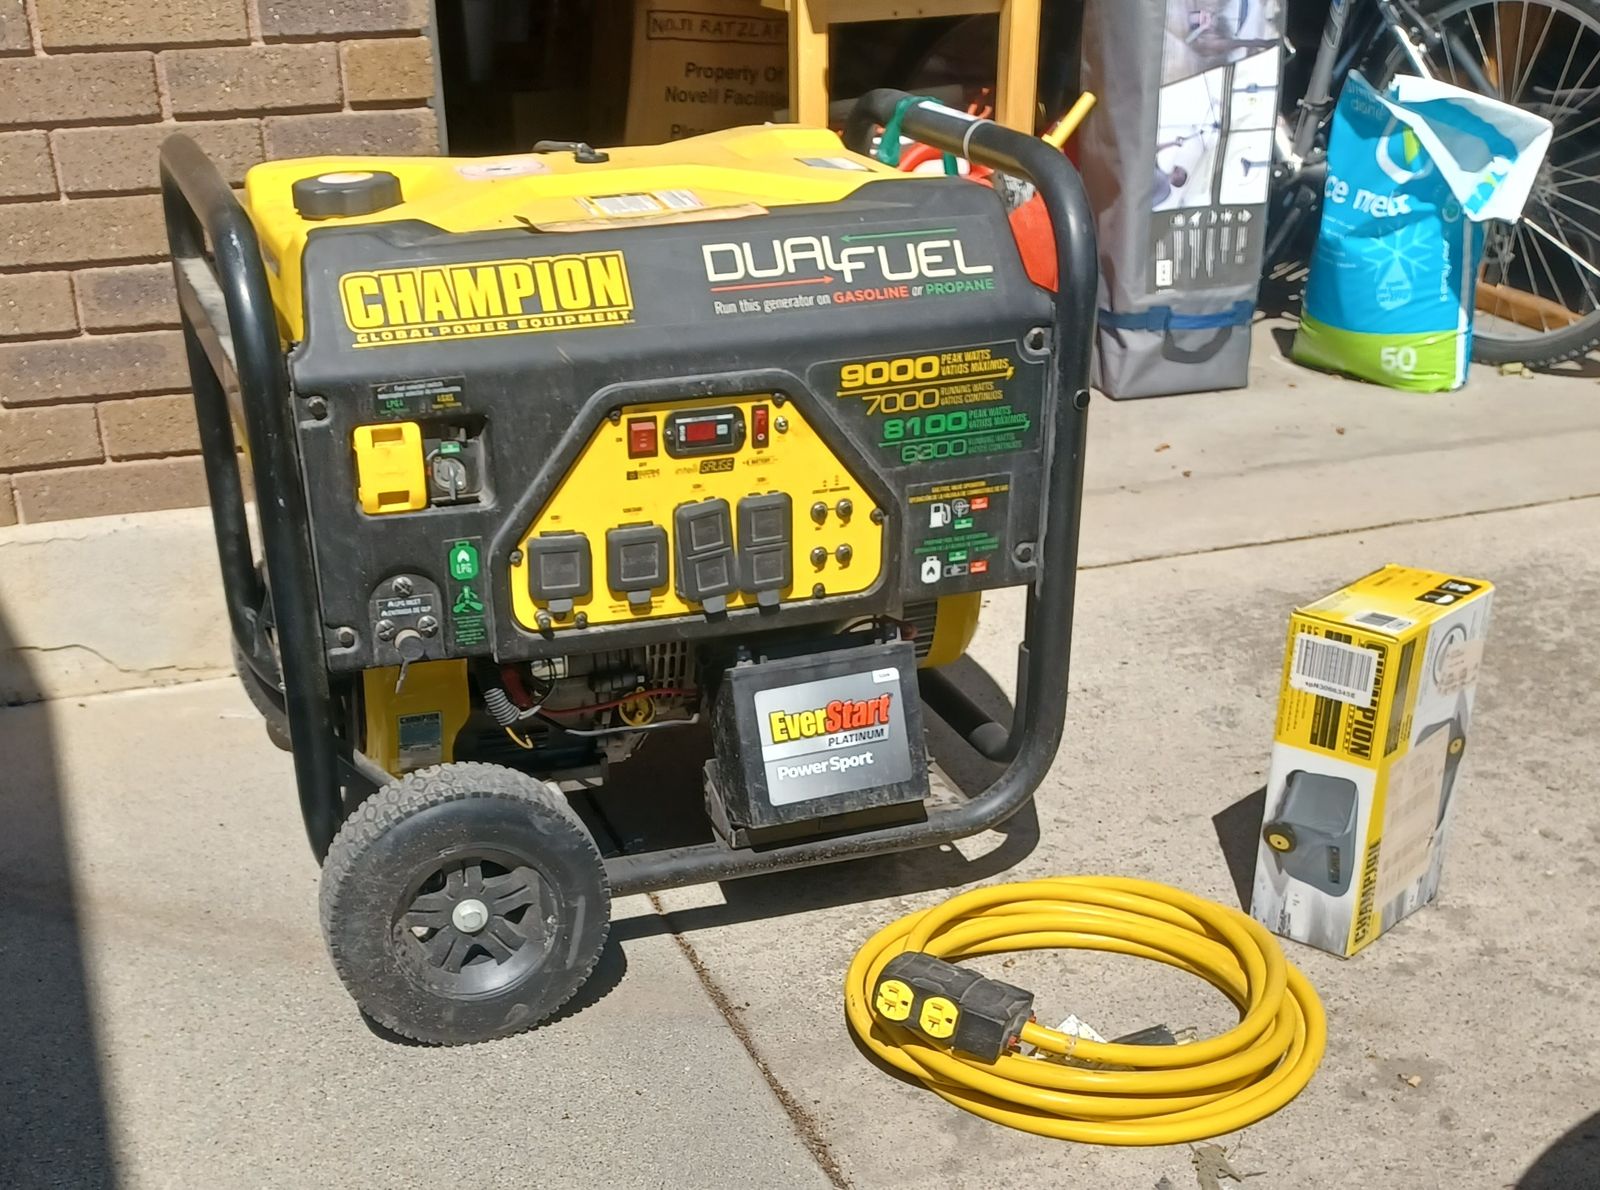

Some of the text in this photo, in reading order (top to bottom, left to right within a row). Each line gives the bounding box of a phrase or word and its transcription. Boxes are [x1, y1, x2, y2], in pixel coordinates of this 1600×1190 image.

[685, 62, 757, 85] Property
[665, 86, 720, 104] Novell
[1324, 175, 1349, 204] ce
[341, 252, 631, 331] CHAMPION
[714, 278, 995, 315] Run this generator on GASOLINE or PROPANE
[357, 310, 629, 345] GLOBAL POWER EQUIPMENT
[941, 349, 992, 365] PEAK WATTS
[1381, 346, 1417, 372] 50
[840, 355, 940, 388] 9000
[862, 388, 940, 416] 7000
[883, 411, 968, 440] 8100
[901, 438, 967, 463] 6300
[768, 693, 891, 744] EverStart
[828, 728, 884, 747] PLATINUM
